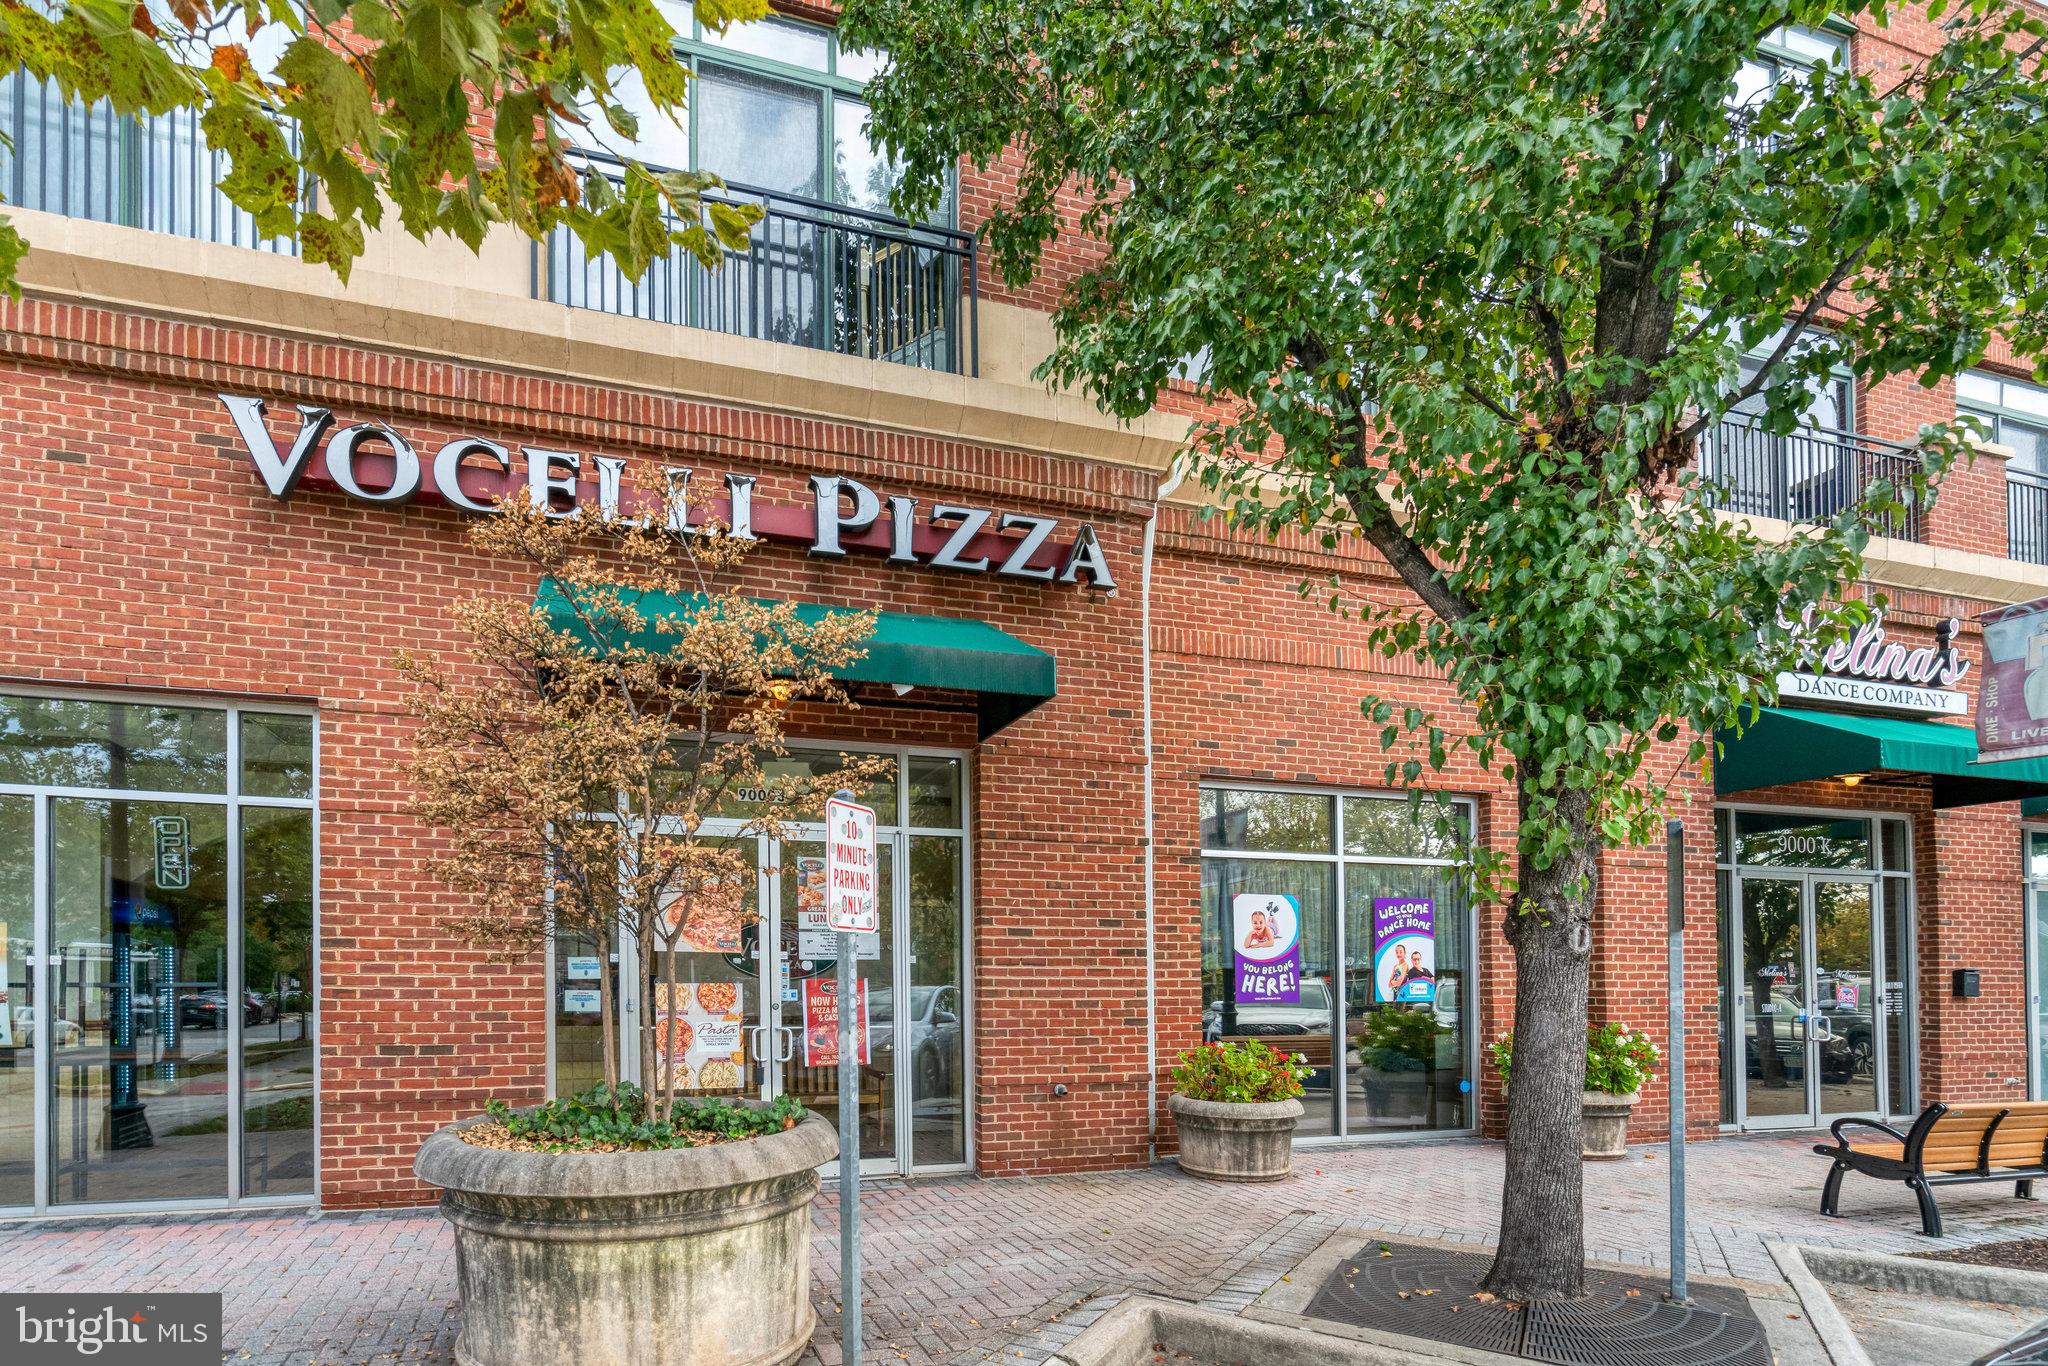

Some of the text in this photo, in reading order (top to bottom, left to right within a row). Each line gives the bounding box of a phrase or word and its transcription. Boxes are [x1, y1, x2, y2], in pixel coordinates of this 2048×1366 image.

[218, 393, 1119, 591] VOCELLI PIZZA
[1797, 677, 1950, 709] DANCE COMPANY
[1985, 677, 1999, 744] DINE SHOP
[846, 820, 858, 840] 10
[160, 821, 183, 885] OPEN
[836, 842, 867, 867] MINUTE
[1778, 835, 1833, 854] 9000 K
[833, 868, 870, 892] PARKING
[841, 894, 863, 915] ONLY
[1379, 903, 1429, 920] WELCOME
[808, 914, 827, 923] LUN
[1378, 918, 1431, 939] DANCE HOME
[1243, 959, 1294, 975] YOU BELONG
[1241, 971, 1296, 997] HERE!
[811, 996, 830, 1006] NOW
[698, 1022, 738, 1035] Pasta
